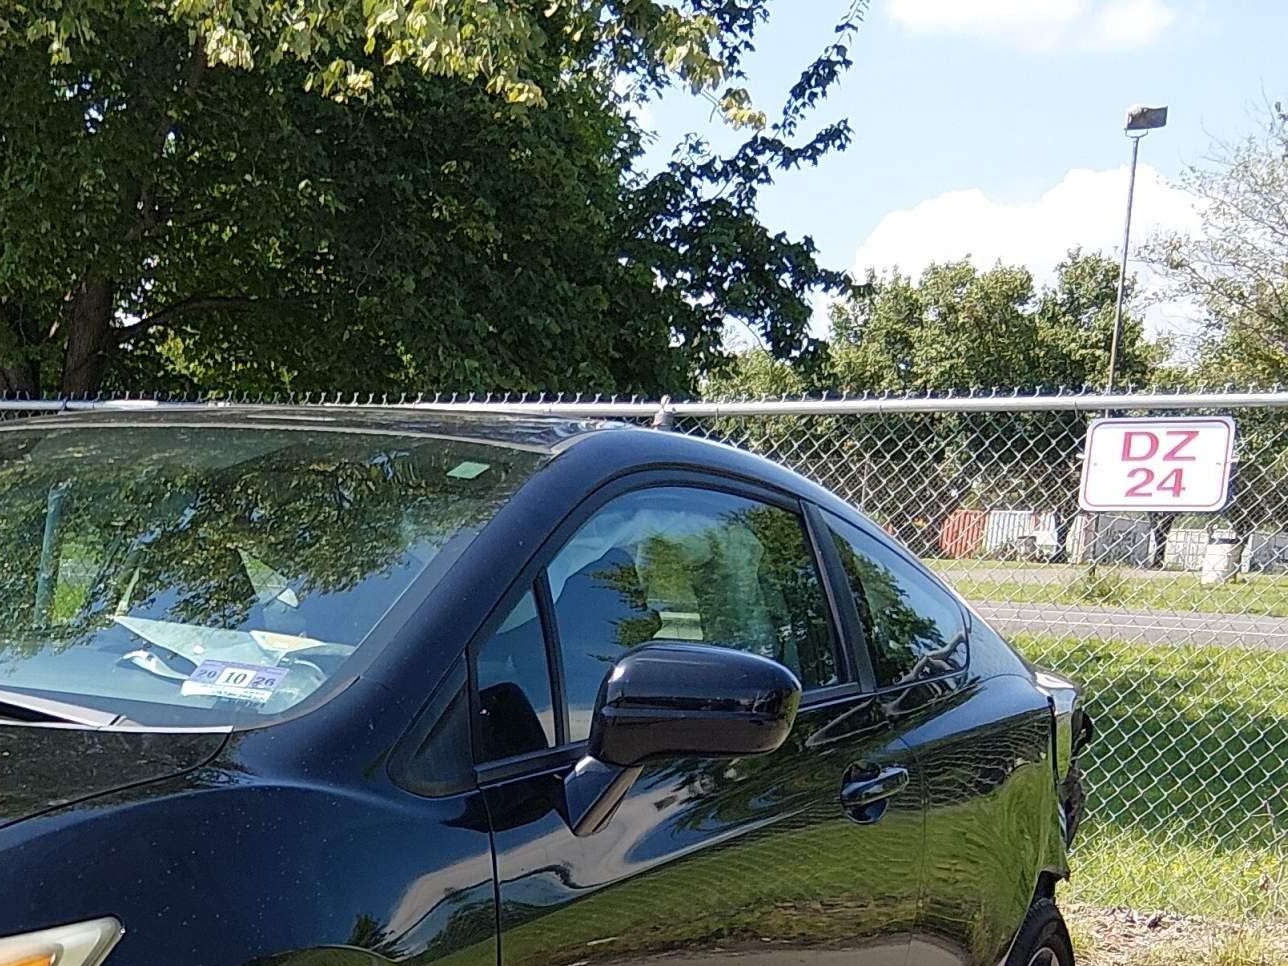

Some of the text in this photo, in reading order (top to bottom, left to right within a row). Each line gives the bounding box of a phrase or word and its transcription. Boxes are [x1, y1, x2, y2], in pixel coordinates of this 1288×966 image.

[1121, 430, 1200, 462] DZ
[1123, 467, 1186, 498] 24
[223, 671, 248, 685] 10
[253, 676, 276, 688] 26
